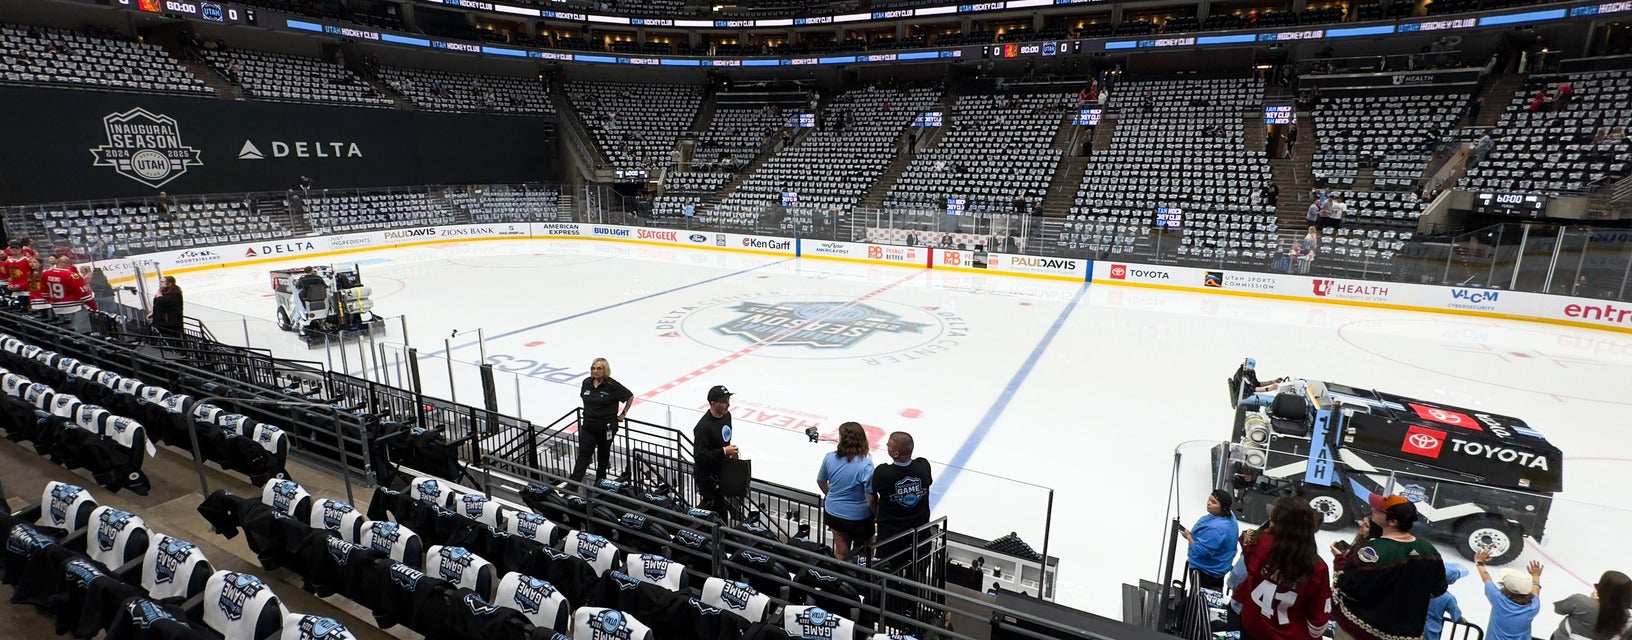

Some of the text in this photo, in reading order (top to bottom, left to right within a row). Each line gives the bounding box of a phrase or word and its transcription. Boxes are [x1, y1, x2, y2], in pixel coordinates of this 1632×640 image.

[166, 1, 196, 14] 60:00
[204, 8, 220, 16] UTAH
[1598, 0, 1632, 14] HOCKE
[228, 10, 238, 20] 0
[1420, 20, 1452, 30] HOCKEY
[1452, 18, 1476, 28] CLUB
[325, 25, 379, 40] UTAH HOCKEY CLUB
[1277, 32, 1304, 40] HOCKEY
[1304, 30, 1324, 38] CLUB
[446, 42, 467, 50] HOCKEY
[467, 45, 480, 53] CLUB
[1060, 44, 1067, 52] 0
[1155, 38, 1178, 46] HOCKEY
[994, 47, 1000, 56] 0
[1020, 46, 1040, 54] 60:00
[110, 124, 175, 136] INAUGURAL
[113, 134, 178, 148] SEASON
[105, 150, 130, 158] 2024
[168, 150, 189, 158] 2025
[272, 142, 362, 158] DELTA
[138, 160, 166, 170] UTAH
[1496, 194, 1522, 203] 60:00
[610, 228, 630, 236] LIGHT
[636, 229, 678, 242] SEATGEEK
[262, 242, 314, 254] DELTA
[750, 238, 790, 250] Ken Garff
[176, 255, 220, 264] MOUNTAINLAND
[102, 264, 120, 272] ACK
[1130, 270, 1170, 280] TOYOTA
[46, 282, 64, 299] 19
[1224, 282, 1274, 290] COMMISSION
[1338, 284, 1388, 296] HEALTH
[1448, 303, 1494, 311] CYBERSECURITY
[656, 306, 698, 330] DELTA
[938, 312, 968, 336] DELTA
[1314, 416, 1330, 480] UTAH
[1452, 438, 1548, 470] TOYOTA
[898, 484, 920, 495] GAME
[274, 494, 290, 506] GAME
[466, 501, 484, 510] GAME
[324, 510, 343, 520] GAME
[520, 518, 538, 530] GAME
[372, 532, 391, 550] GAME
[580, 540, 600, 554] GAME
[158, 550, 178, 572] GAME
[441, 557, 463, 575] GAME
[644, 560, 668, 570] GAME
[392, 563, 424, 580] GAME
[223, 582, 246, 606] GAME
[519, 582, 541, 604] GAME
[724, 582, 749, 602] GAME
[804, 625, 830, 636] GAME
